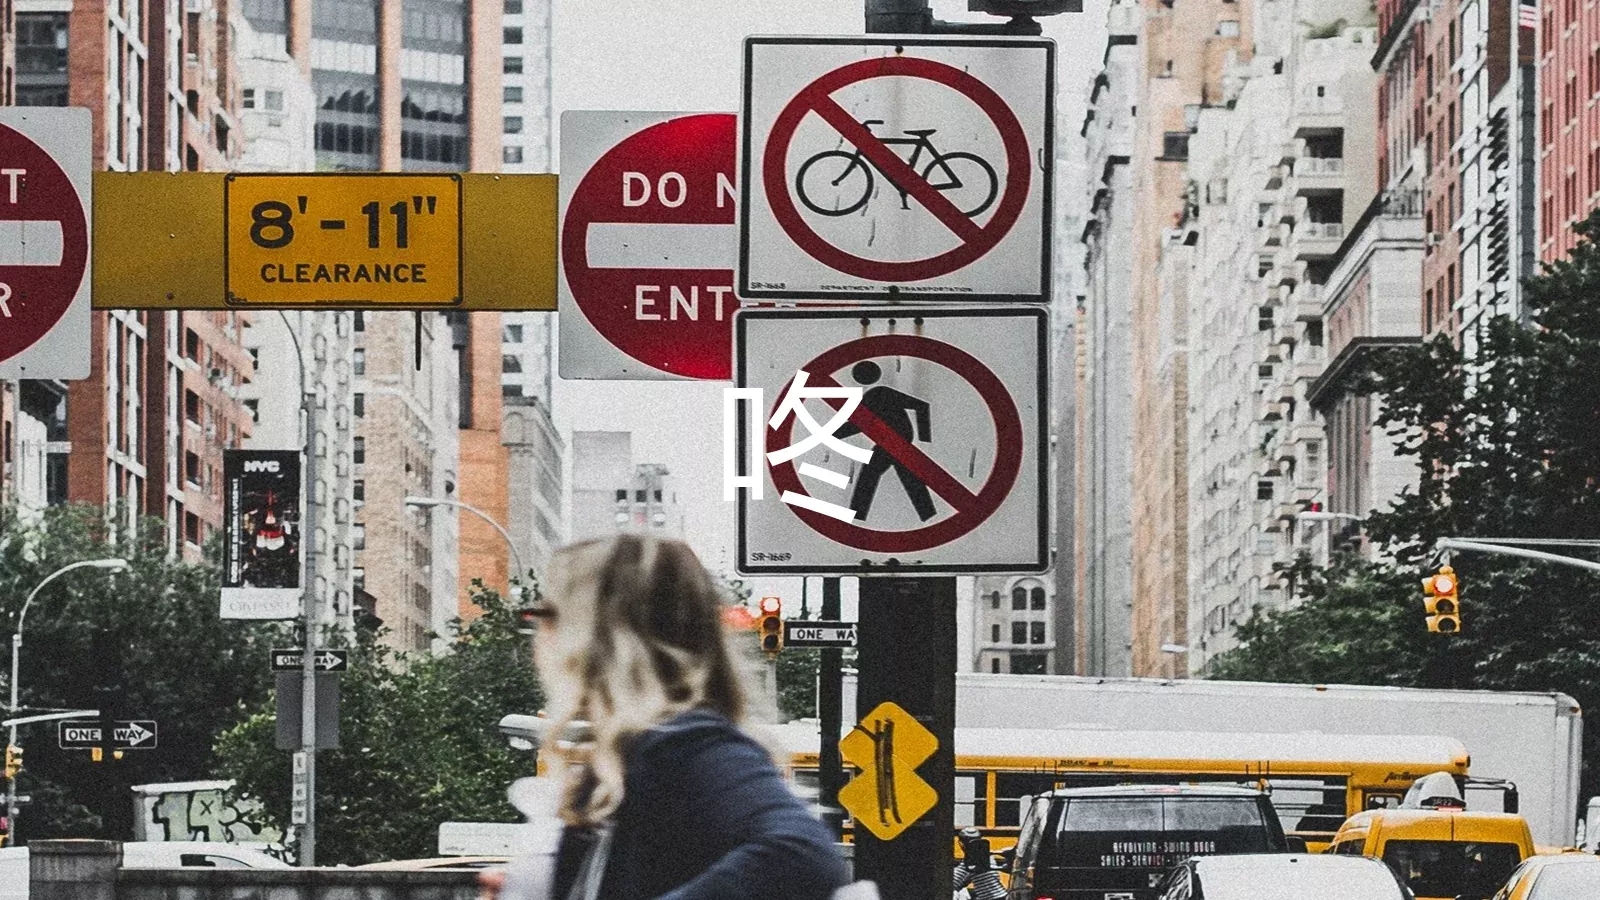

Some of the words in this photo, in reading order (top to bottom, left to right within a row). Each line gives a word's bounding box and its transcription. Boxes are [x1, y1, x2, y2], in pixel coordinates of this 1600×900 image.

[1, 168, 27, 204] T
[623, 171, 687, 208] DO
[260, 263, 427, 283] CLEARANCE
[636, 285, 797, 321] ENT
[244, 461, 280, 472] NYC
[751, 552, 792, 561] SR-1669
[797, 629, 823, 639] ONE
[68, 729, 99, 740] ONE
[116, 729, 144, 740] WAY
[1194, 841, 1216, 852] DOOR
[1101, 855, 1126, 866] SALES
